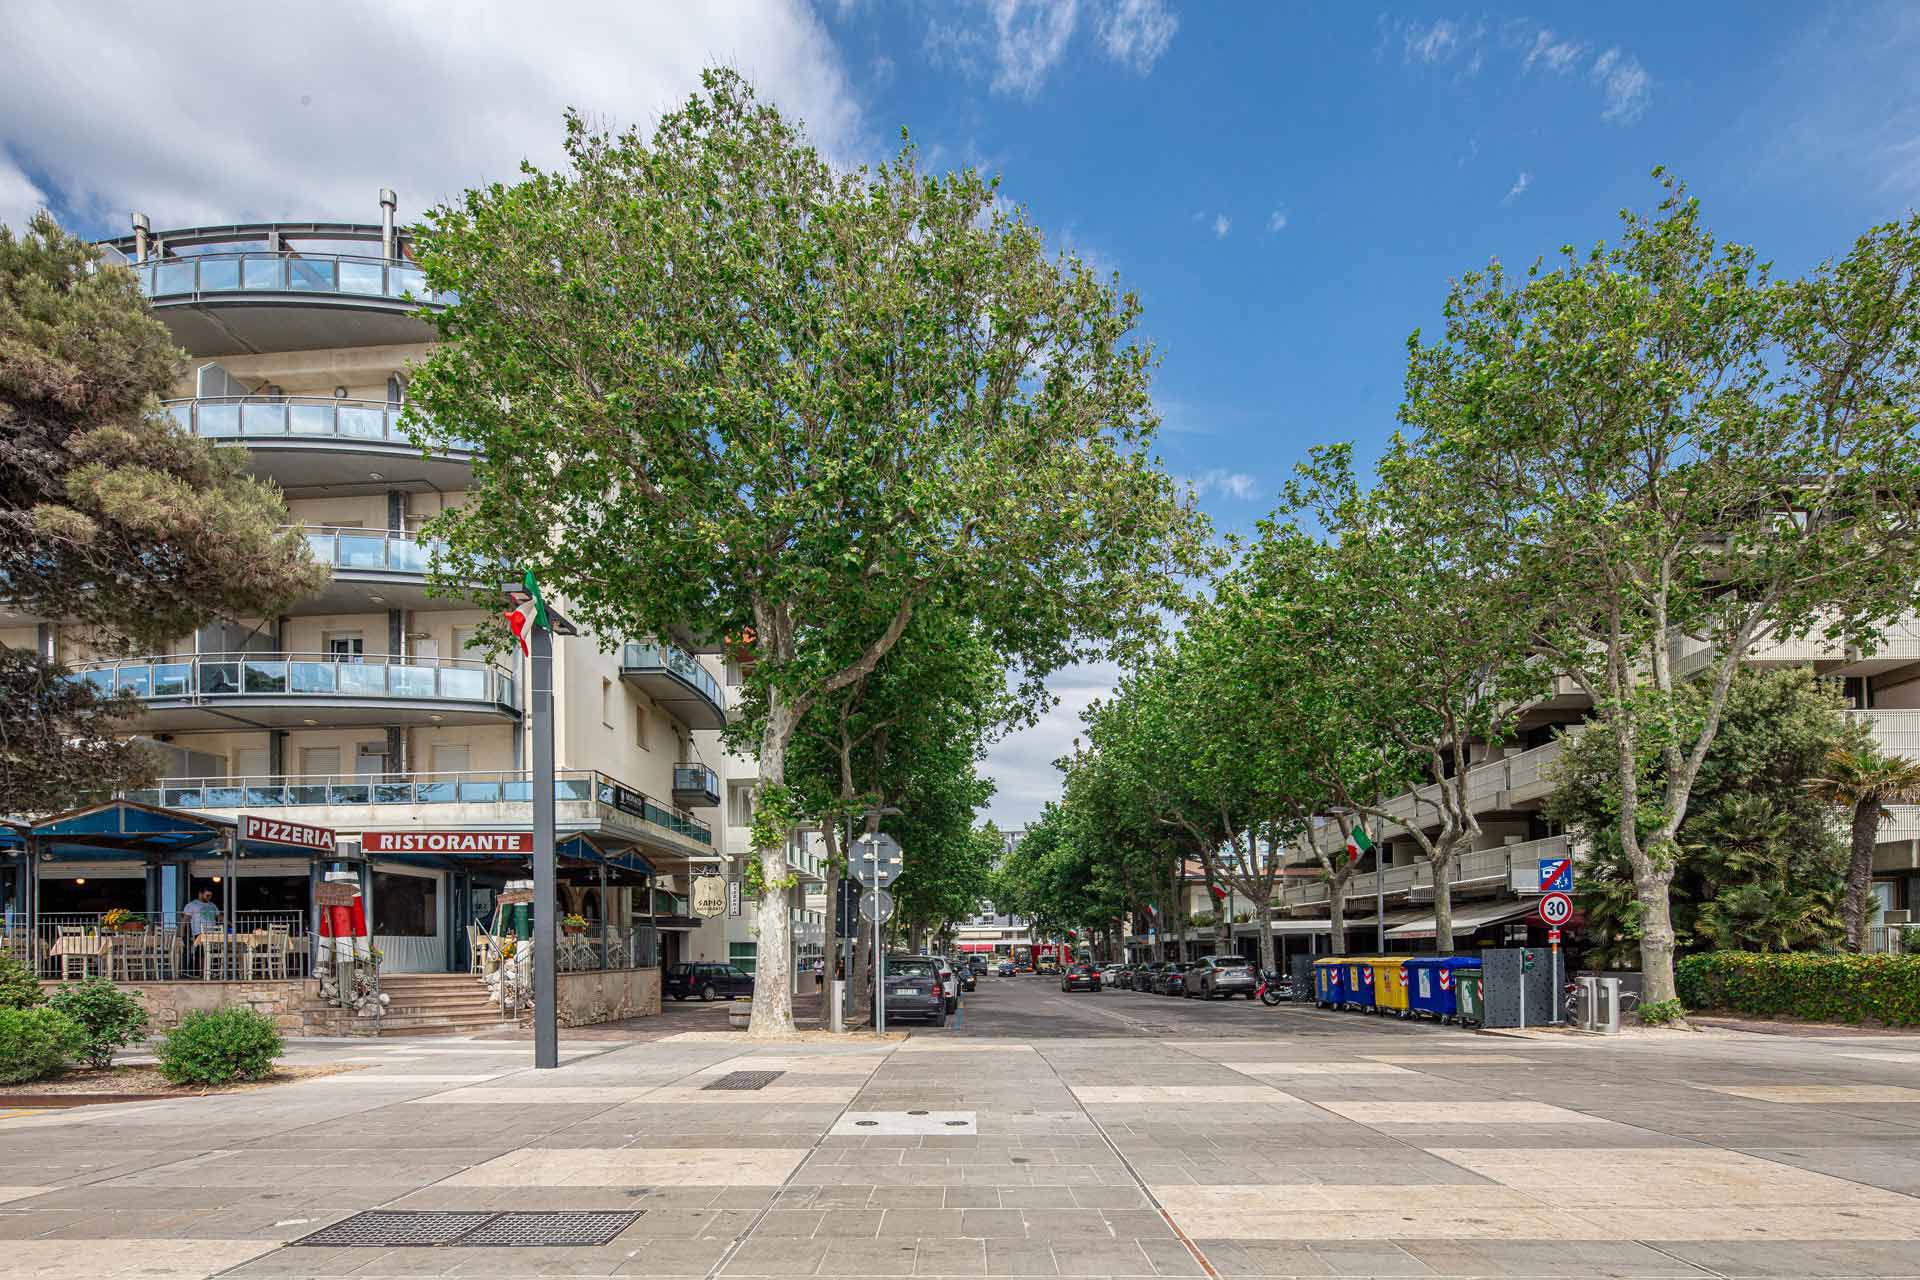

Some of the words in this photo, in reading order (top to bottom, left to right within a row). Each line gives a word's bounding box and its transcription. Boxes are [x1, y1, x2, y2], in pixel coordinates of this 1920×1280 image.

[248, 819, 333, 848] PIZZERIA
[380, 834, 521, 850] RISTORANTE
[1547, 901, 1565, 916] 30
